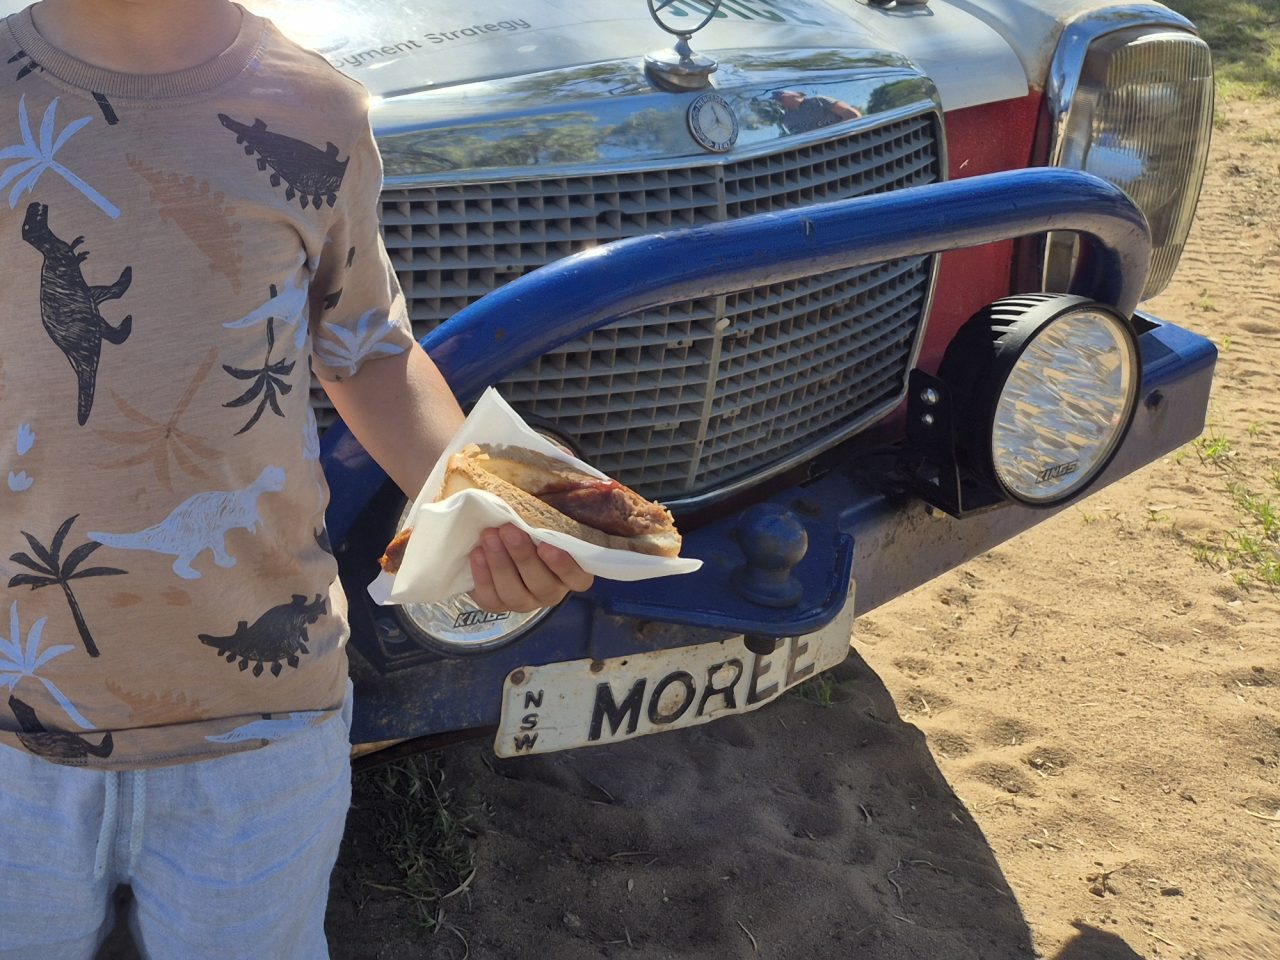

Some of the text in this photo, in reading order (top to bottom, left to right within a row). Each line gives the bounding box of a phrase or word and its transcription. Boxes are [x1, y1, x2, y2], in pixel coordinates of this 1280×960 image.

[335, 18, 532, 68] oyment Strategy
[587, 637, 816, 741] MOREE
